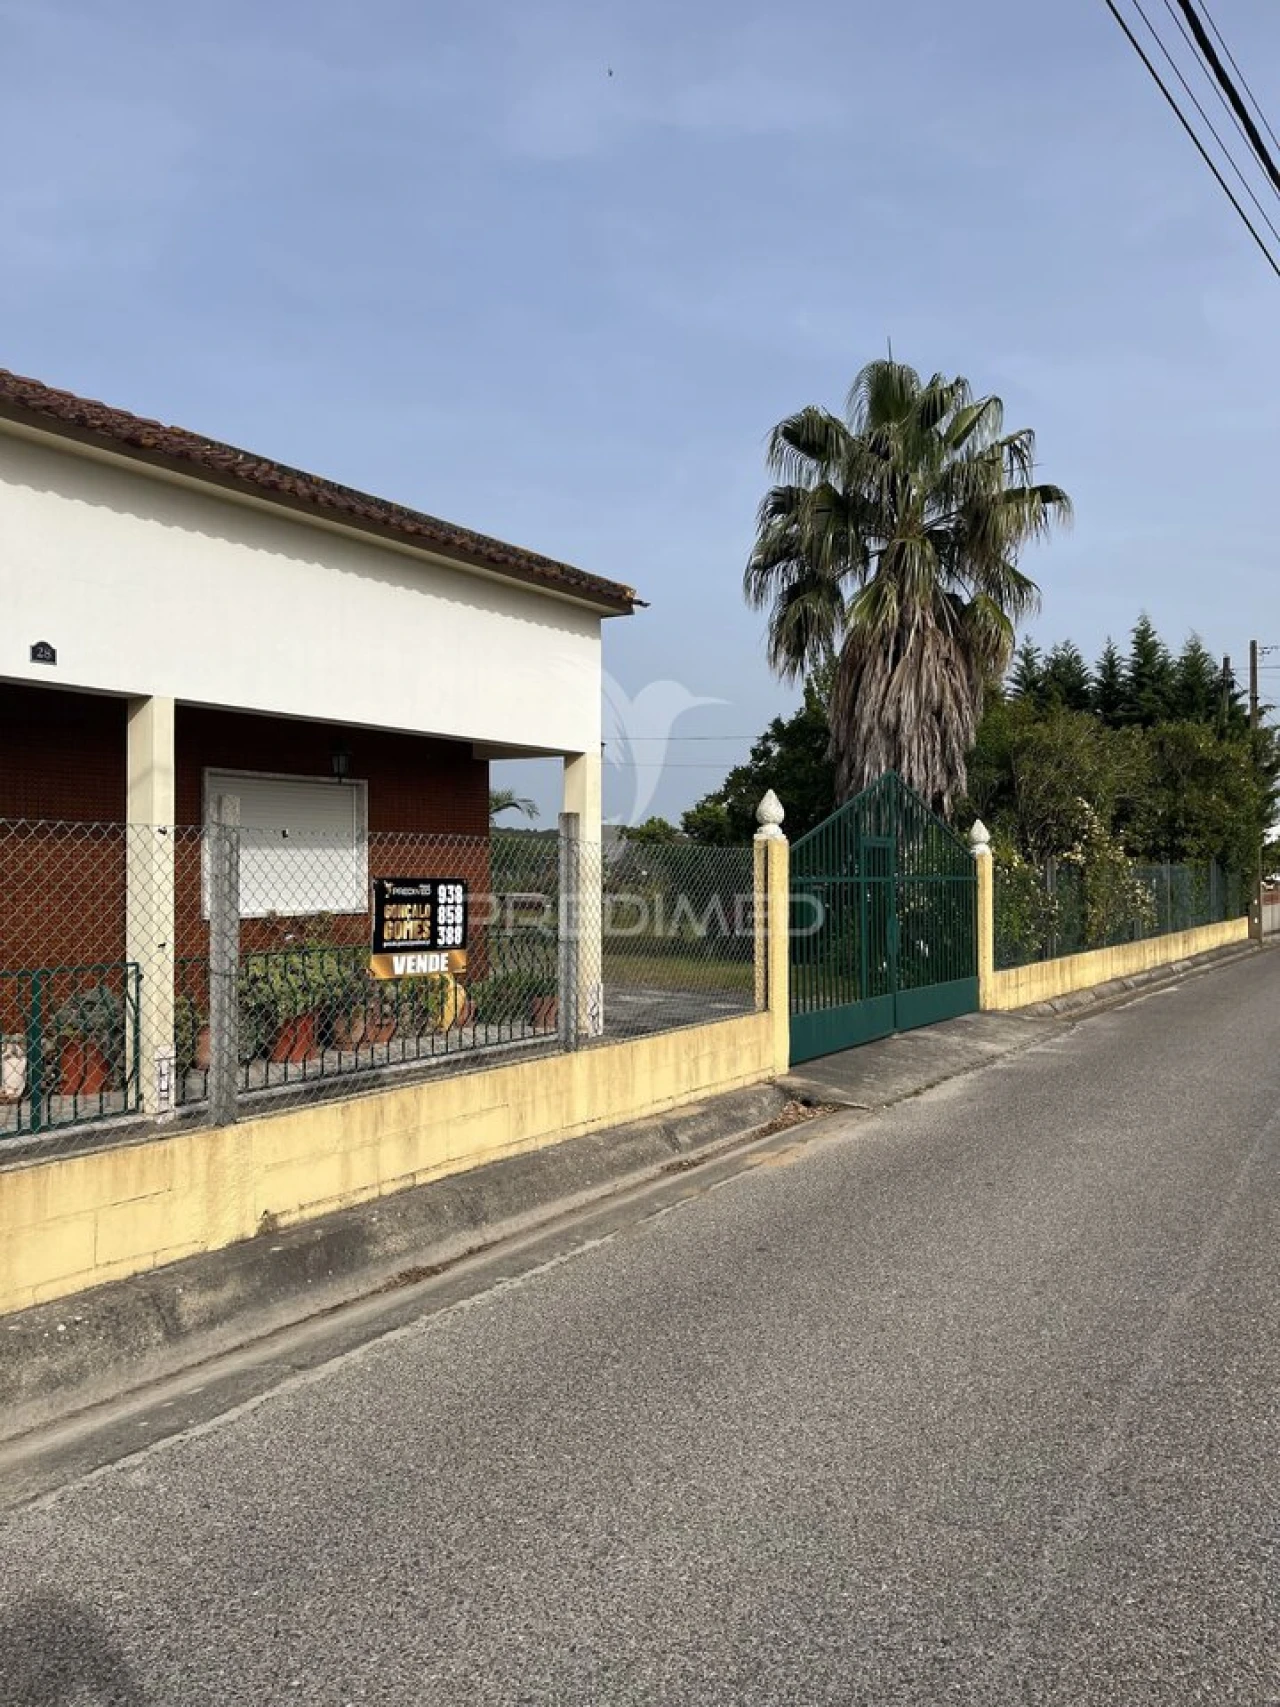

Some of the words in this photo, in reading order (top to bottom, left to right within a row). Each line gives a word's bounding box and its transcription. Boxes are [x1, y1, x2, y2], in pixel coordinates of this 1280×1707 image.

[437, 884, 463, 904] 938
[437, 904, 463, 925] 858
[384, 920, 431, 940] GOMES
[437, 926, 463, 945] 388
[393, 953, 449, 975] VENDE
